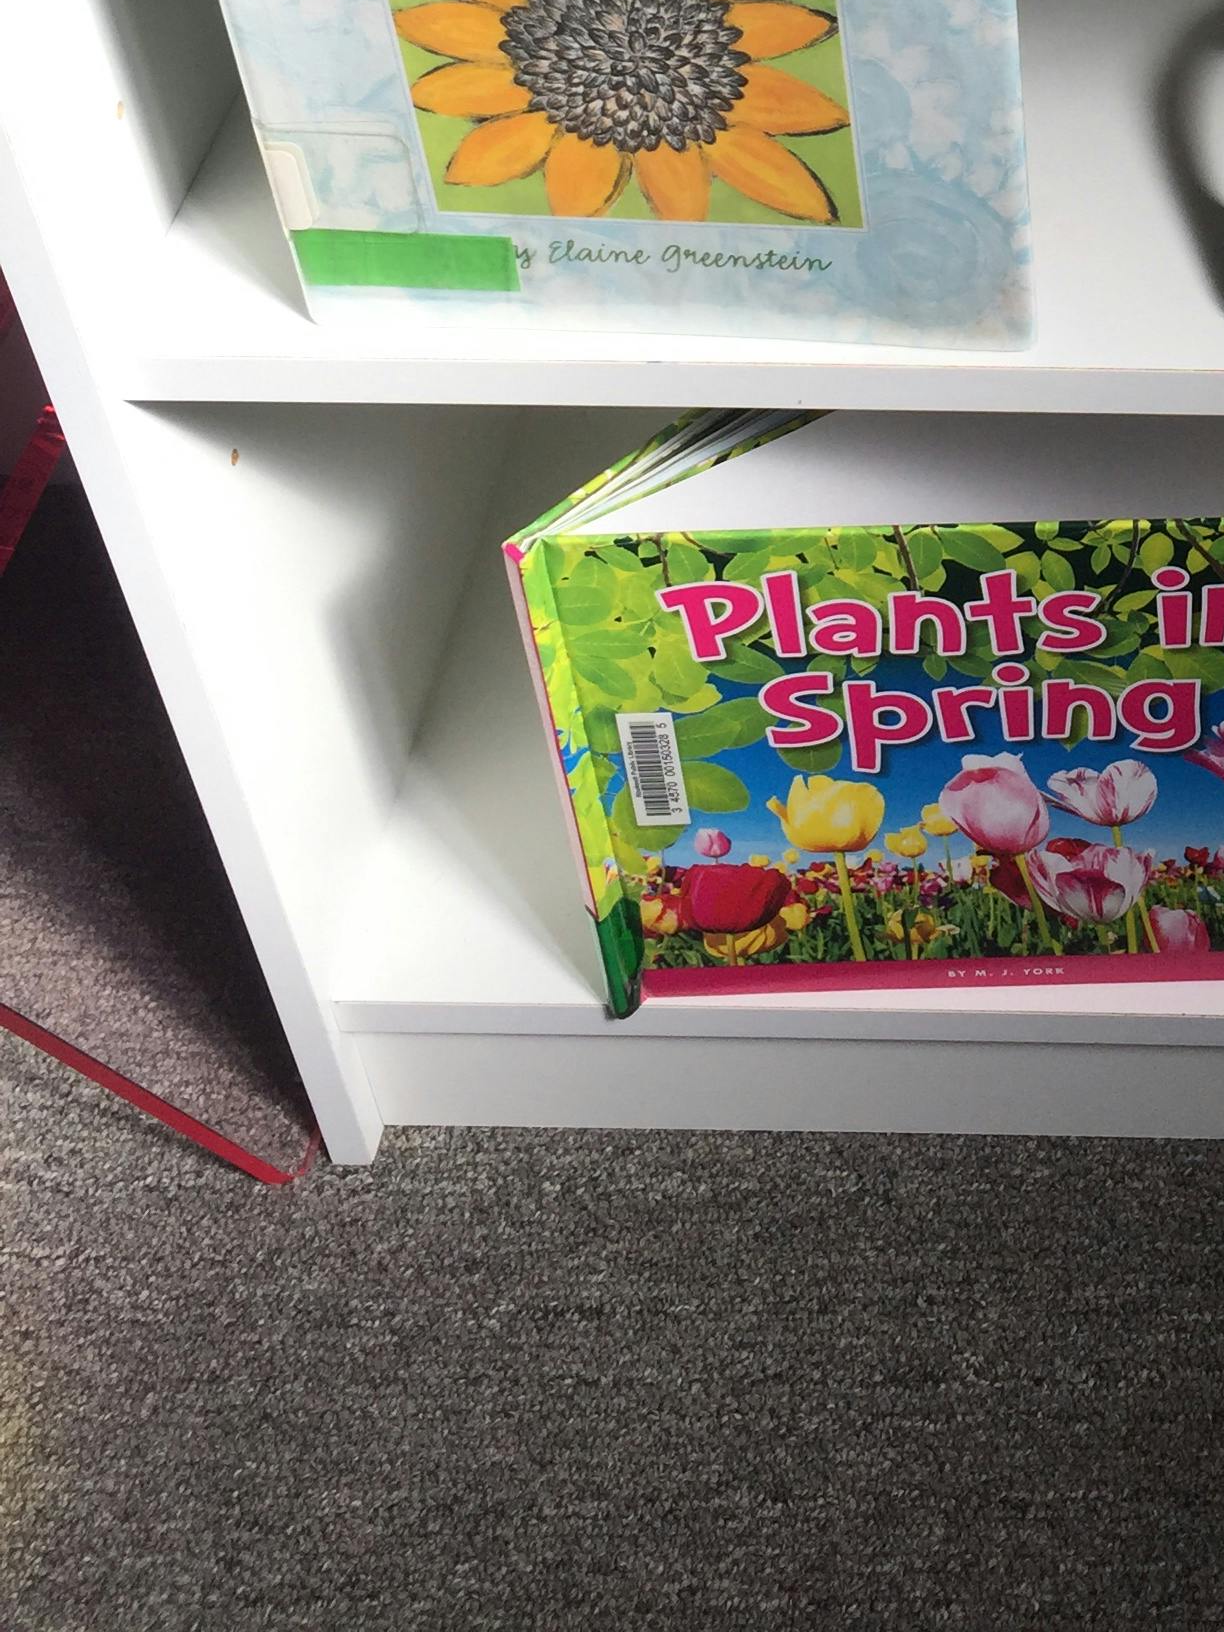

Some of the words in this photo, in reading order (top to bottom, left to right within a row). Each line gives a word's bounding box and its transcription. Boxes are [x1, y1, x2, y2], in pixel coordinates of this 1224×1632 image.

[548, 239, 651, 265] Elaine
[661, 244, 833, 273] Greenstein
[659, 568, 1107, 662] Plants
[758, 663, 1203, 775] Spring
[947, 969, 966, 978] BY
[975, 969, 994, 977] M.
[1001, 969, 1014, 977] J.
[1023, 967, 1065, 976] YORK
